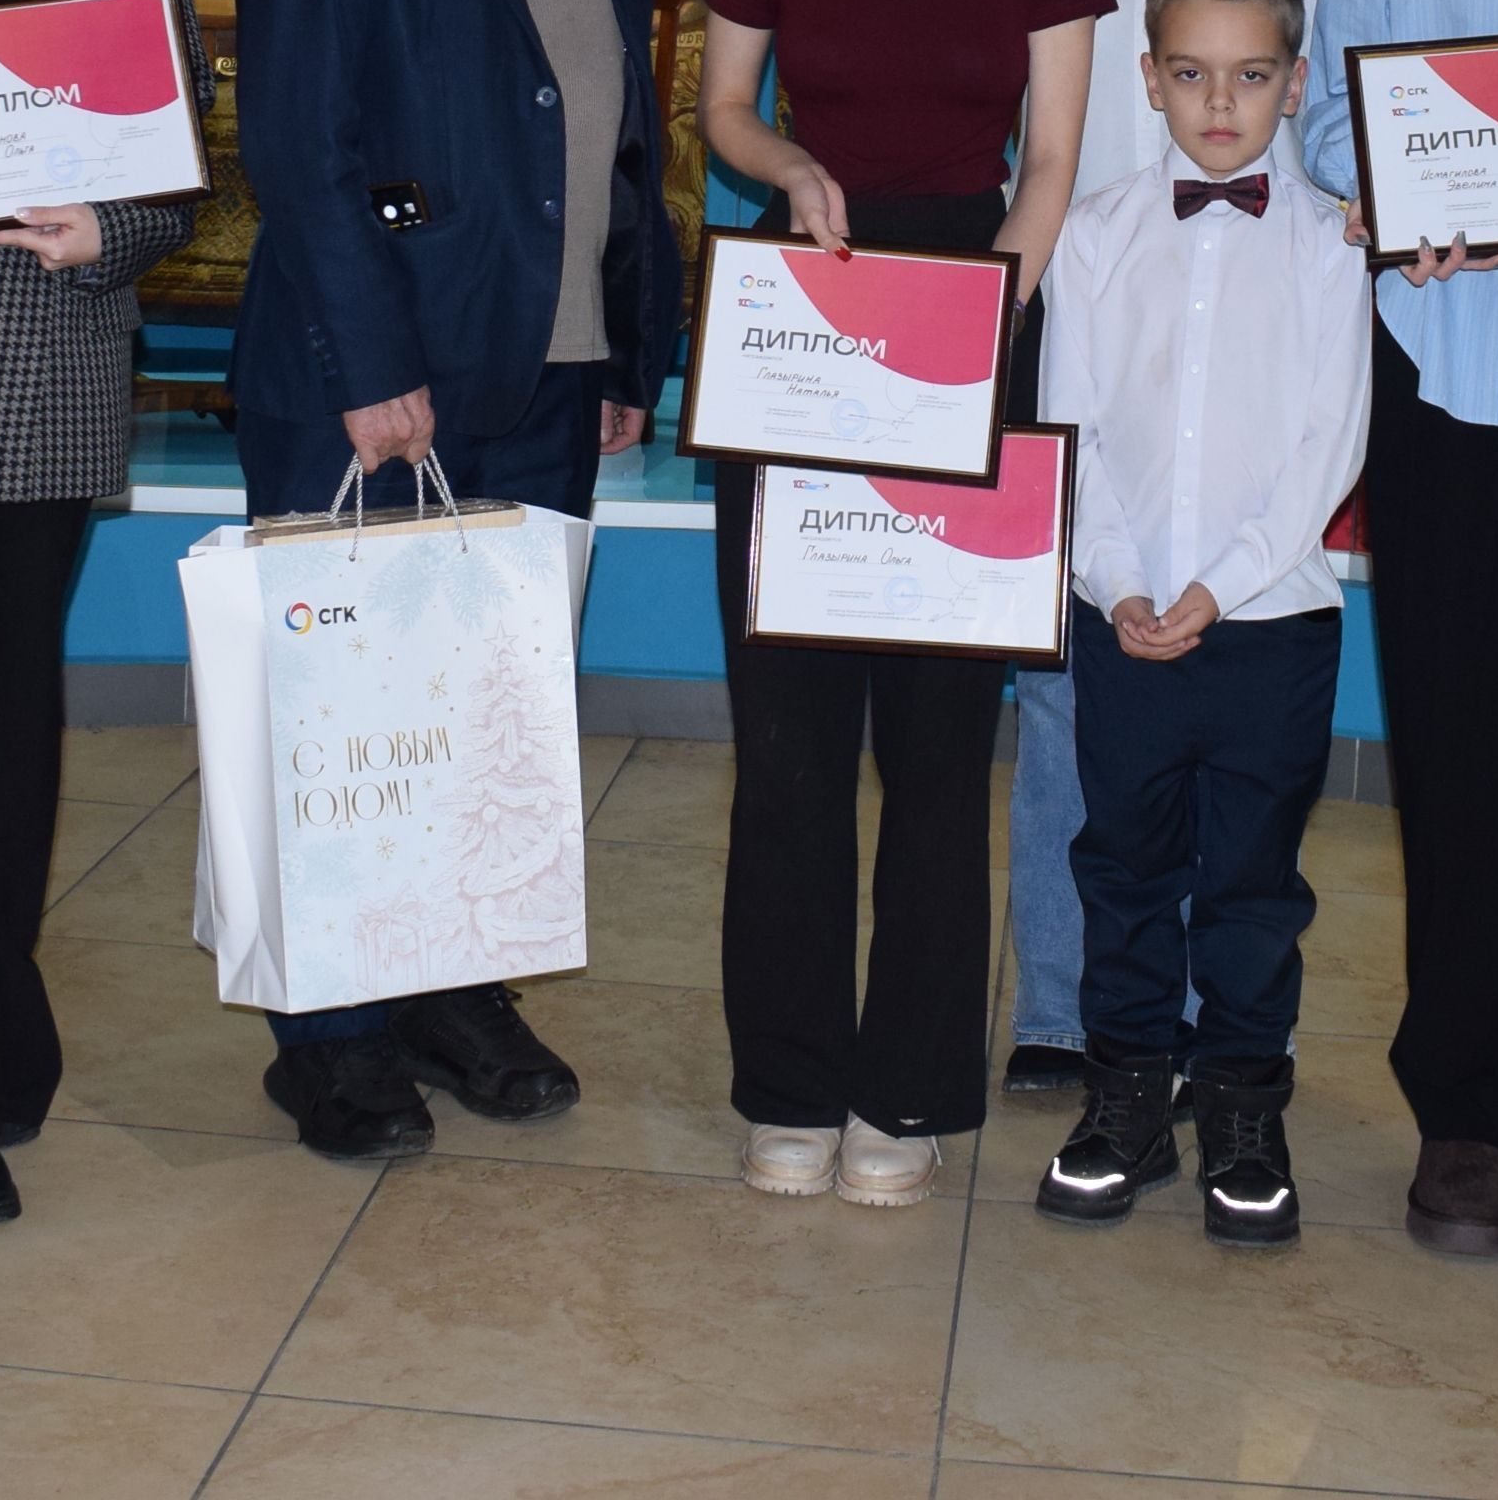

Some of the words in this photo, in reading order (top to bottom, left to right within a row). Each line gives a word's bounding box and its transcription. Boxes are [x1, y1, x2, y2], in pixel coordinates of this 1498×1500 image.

[1407, 86, 1429, 96] СГК
[756, 278, 777, 289] СГК
[741, 327, 887, 360] ДИПЛОМ
[799, 509, 946, 537] ДИПЛОМ
[318, 605, 358, 625] СГК
[292, 739, 325, 779] С
[347, 726, 452, 773] НОВЫМ
[294, 779, 412, 830] ГОДОМ!
